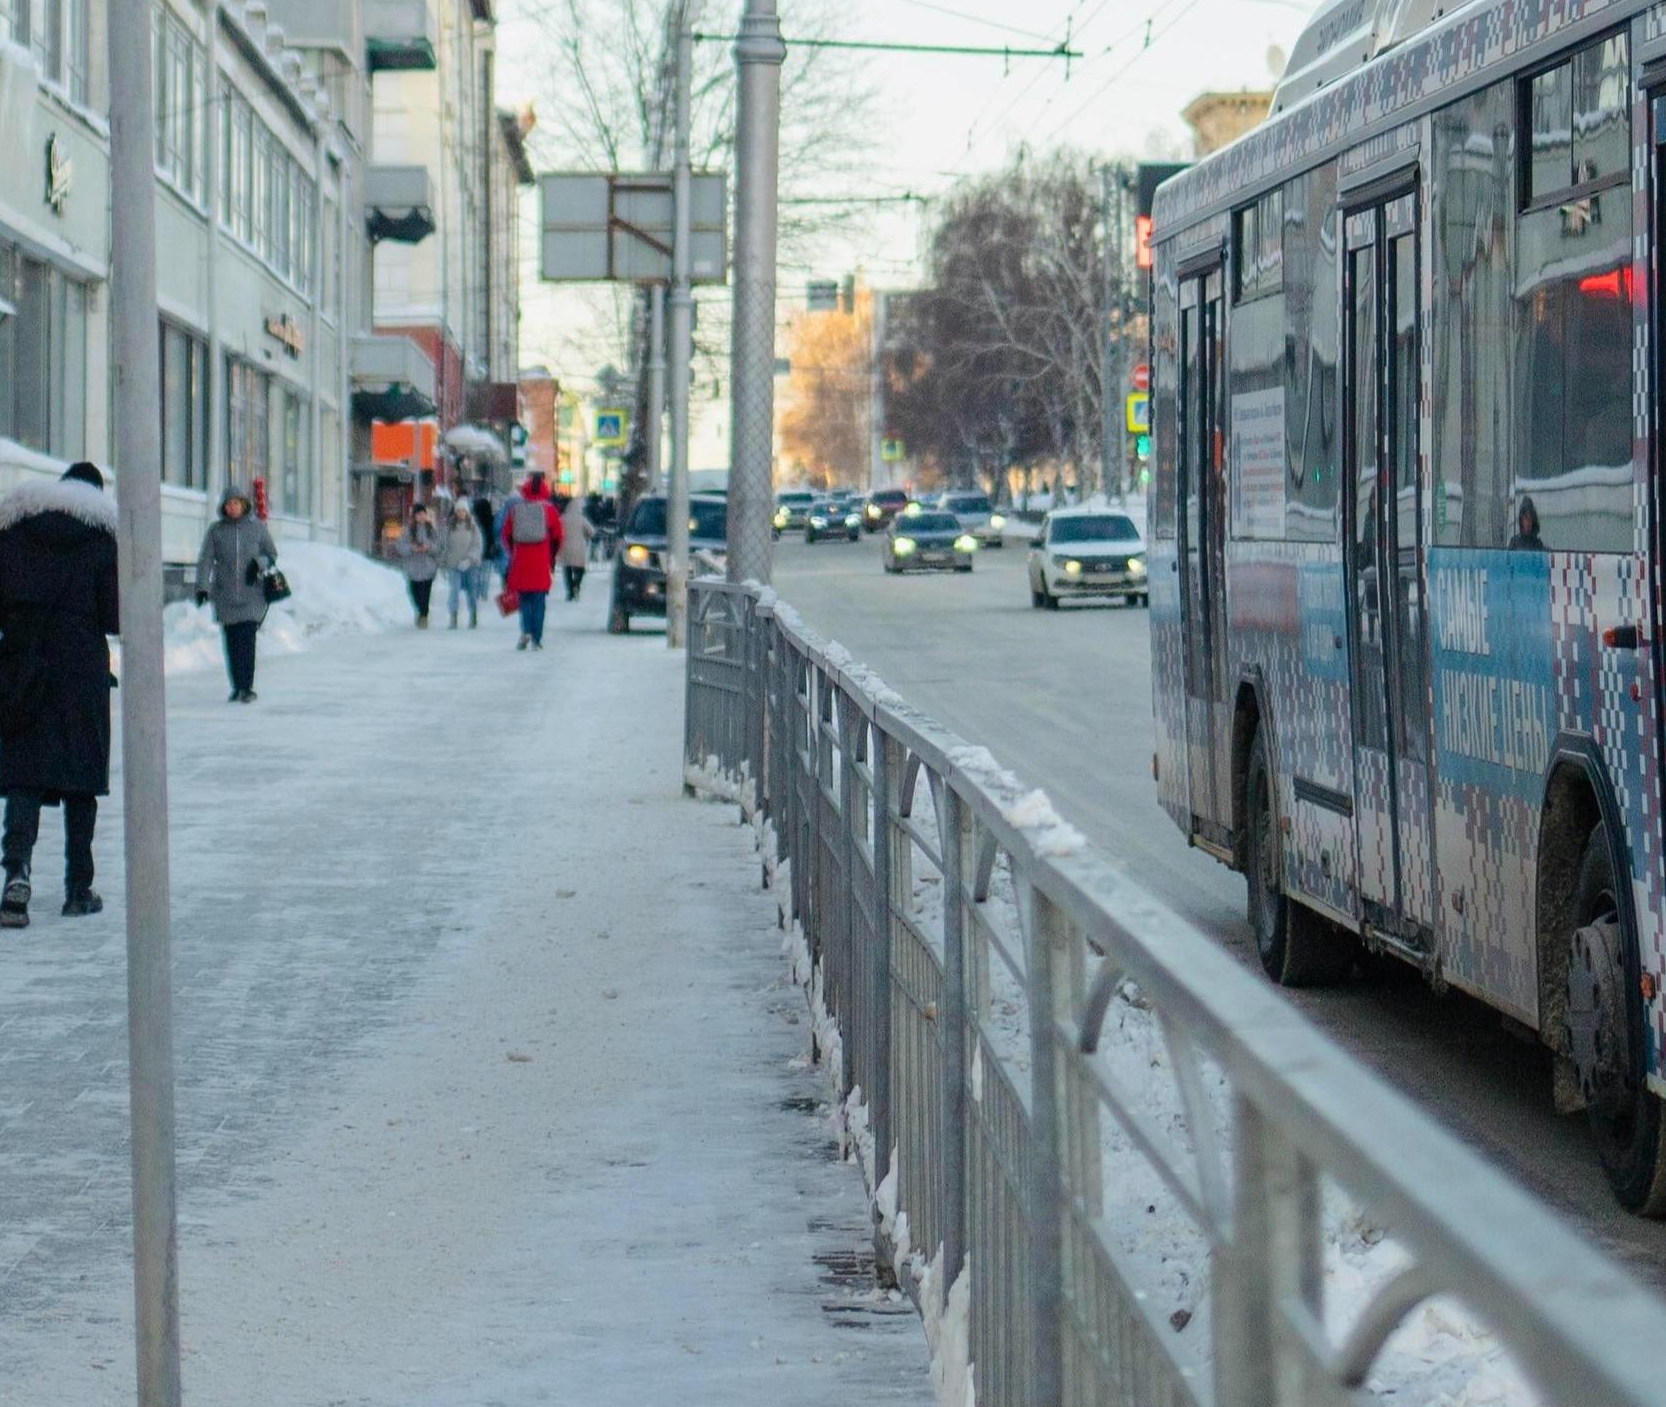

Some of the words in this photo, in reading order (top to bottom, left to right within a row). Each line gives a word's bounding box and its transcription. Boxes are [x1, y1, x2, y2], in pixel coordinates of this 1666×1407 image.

[1437, 567, 1490, 656] САМЫЕ
[1442, 669, 1499, 764] НИЗКИЕ
[1501, 678, 1549, 784] ЦЕНЫ
